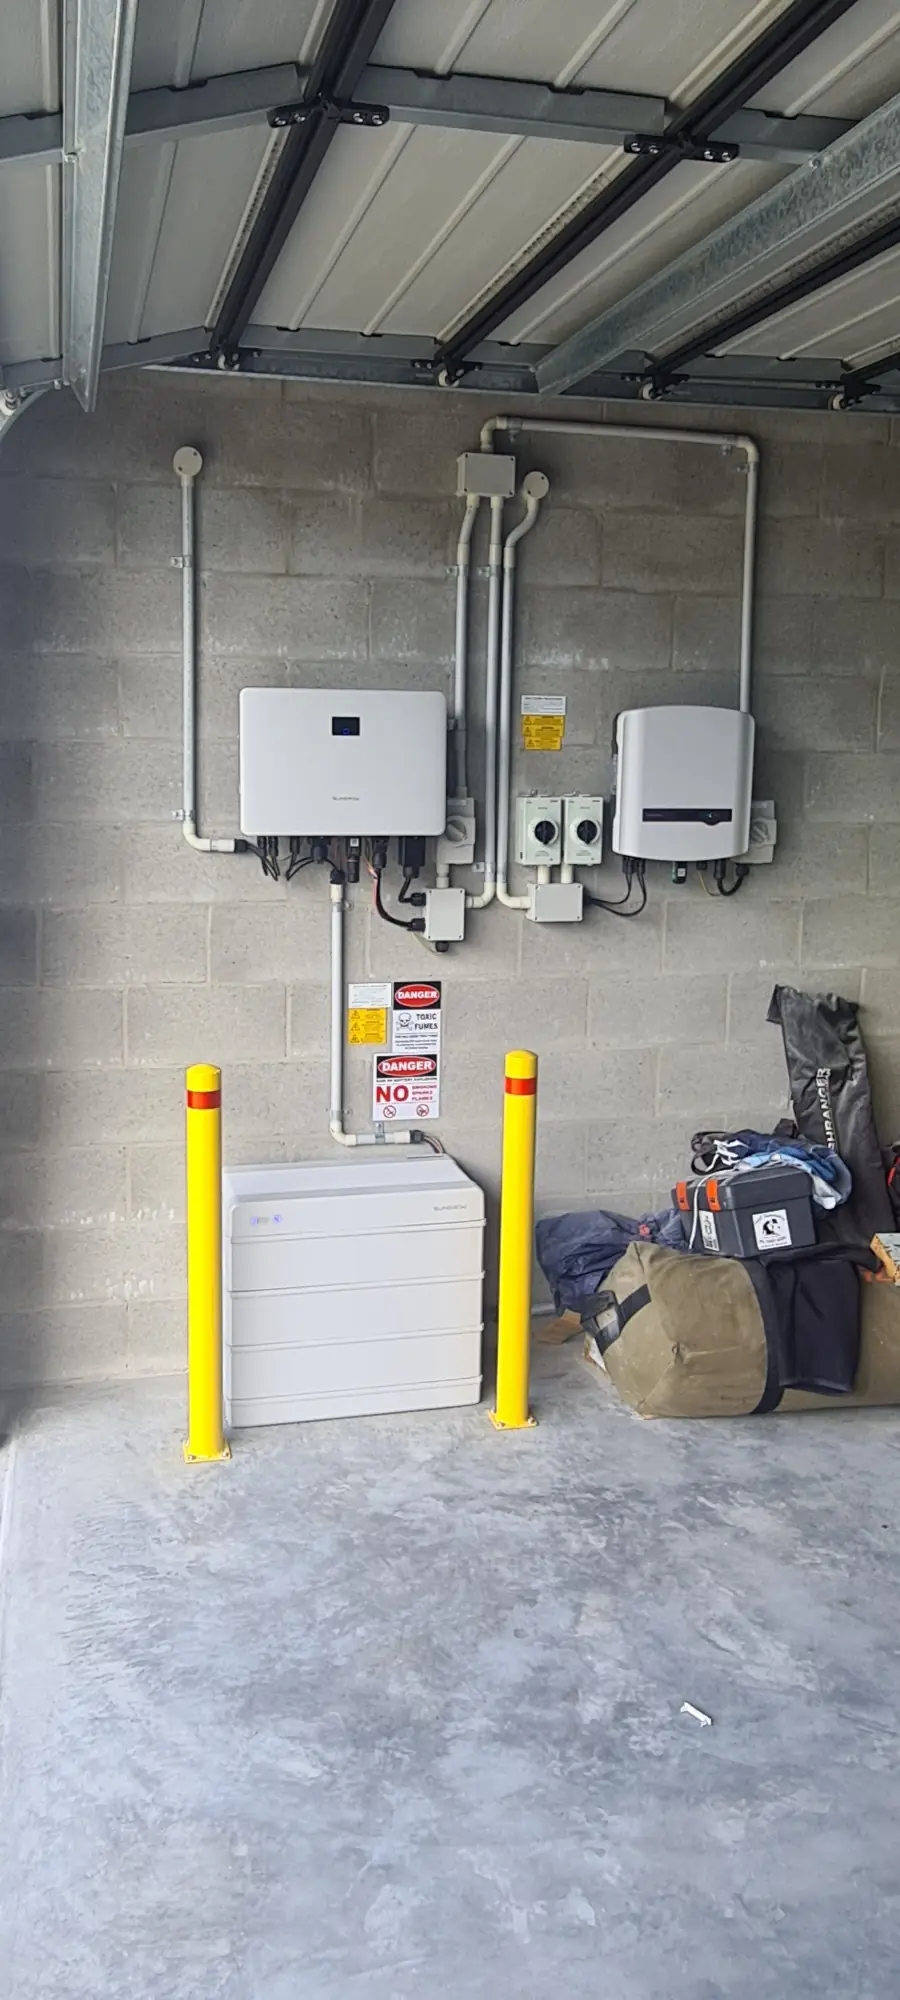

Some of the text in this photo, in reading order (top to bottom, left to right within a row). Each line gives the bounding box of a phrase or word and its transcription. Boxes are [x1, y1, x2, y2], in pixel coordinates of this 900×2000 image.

[398, 991, 438, 1000] DANGER
[416, 1013, 437, 1021] TOXIC
[414, 1022, 438, 1030] FUMES
[382, 1061, 432, 1072] DANGER
[376, 1085, 409, 1103] NO
